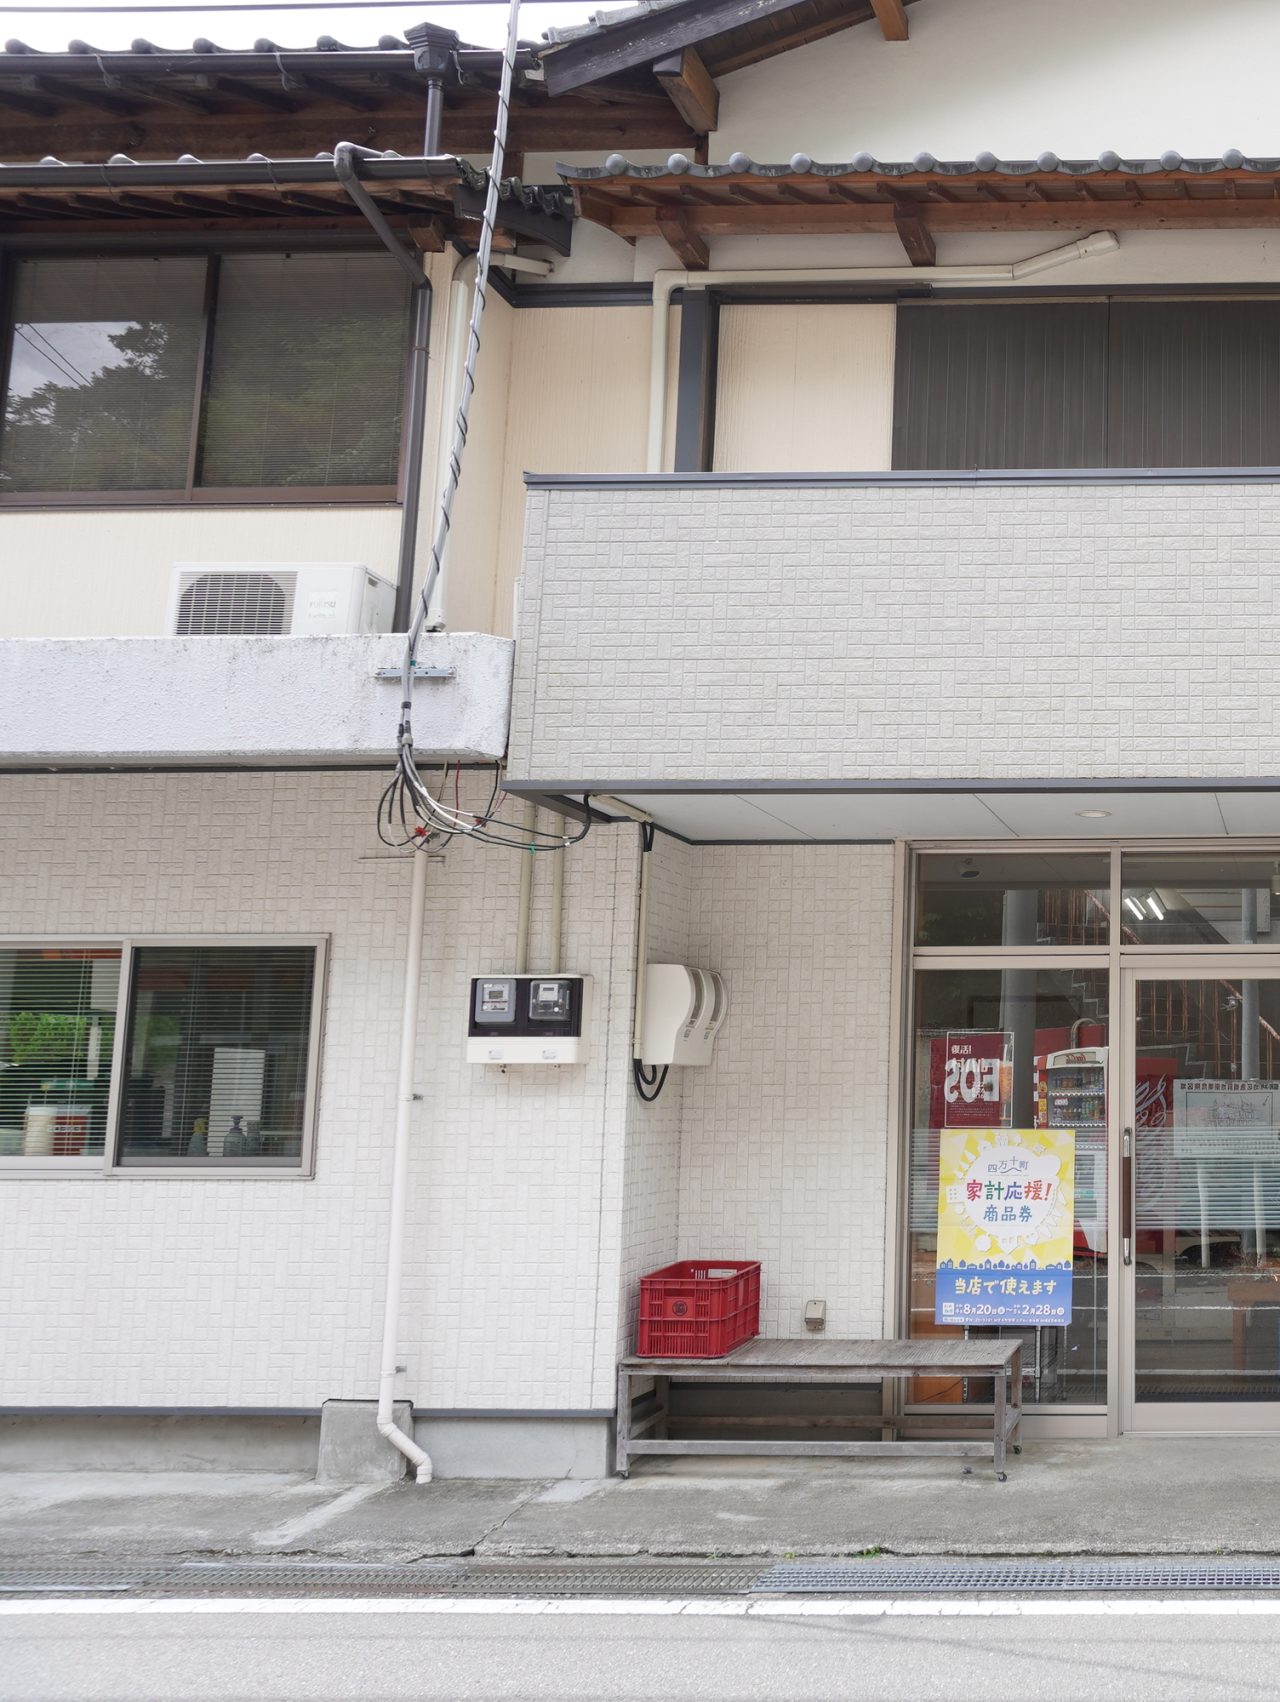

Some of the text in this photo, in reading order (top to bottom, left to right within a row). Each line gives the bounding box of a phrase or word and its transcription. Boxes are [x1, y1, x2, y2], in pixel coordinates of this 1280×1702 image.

[987, 1155, 1029, 1173] 四万十町
[966, 1180, 1052, 1201] 家計応援!
[984, 1204, 1032, 1222] 商品券
[955, 1276, 1056, 1295] 当店で使えます
